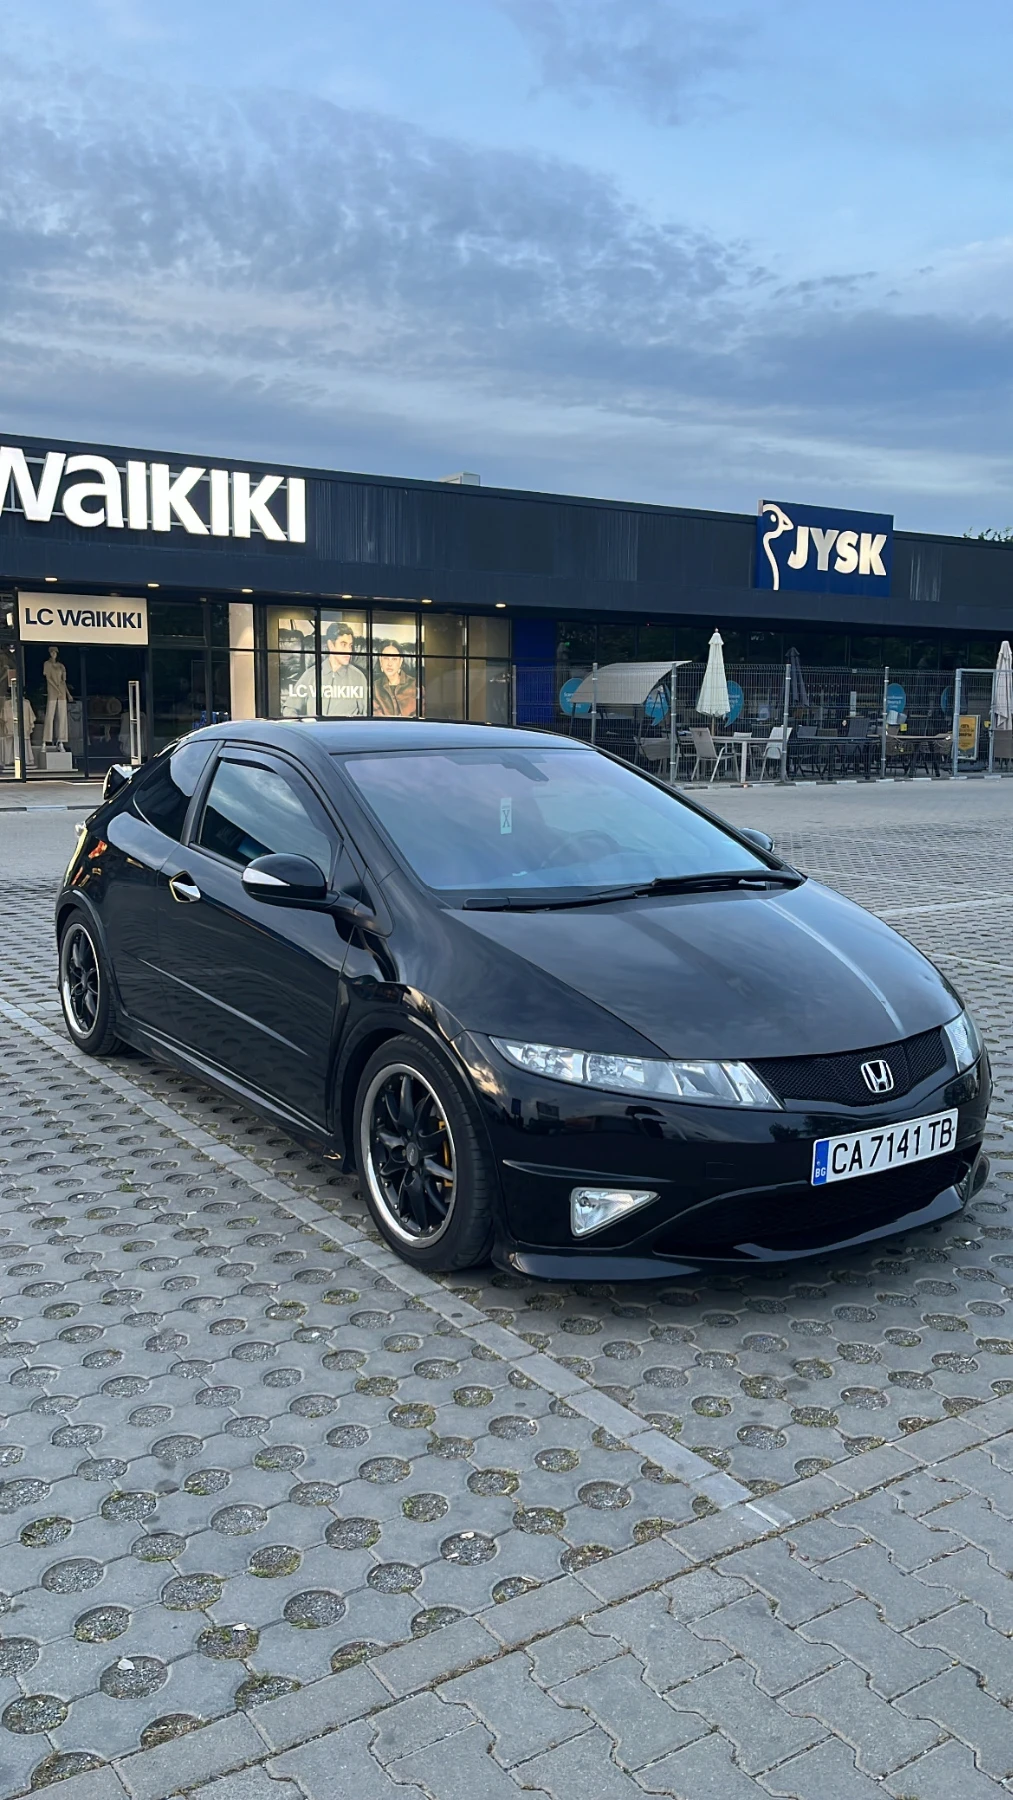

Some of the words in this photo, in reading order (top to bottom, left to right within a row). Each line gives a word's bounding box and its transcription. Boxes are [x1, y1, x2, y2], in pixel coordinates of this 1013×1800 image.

[787, 526, 887, 576] JYSK
[25, 608, 54, 625] LC
[288, 684, 307, 698] LC
[832, 1139, 863, 1174] CA
[869, 1125, 921, 1168] 7141
[928, 1117, 953, 1152] TB
[815, 1167, 827, 1178] BG
